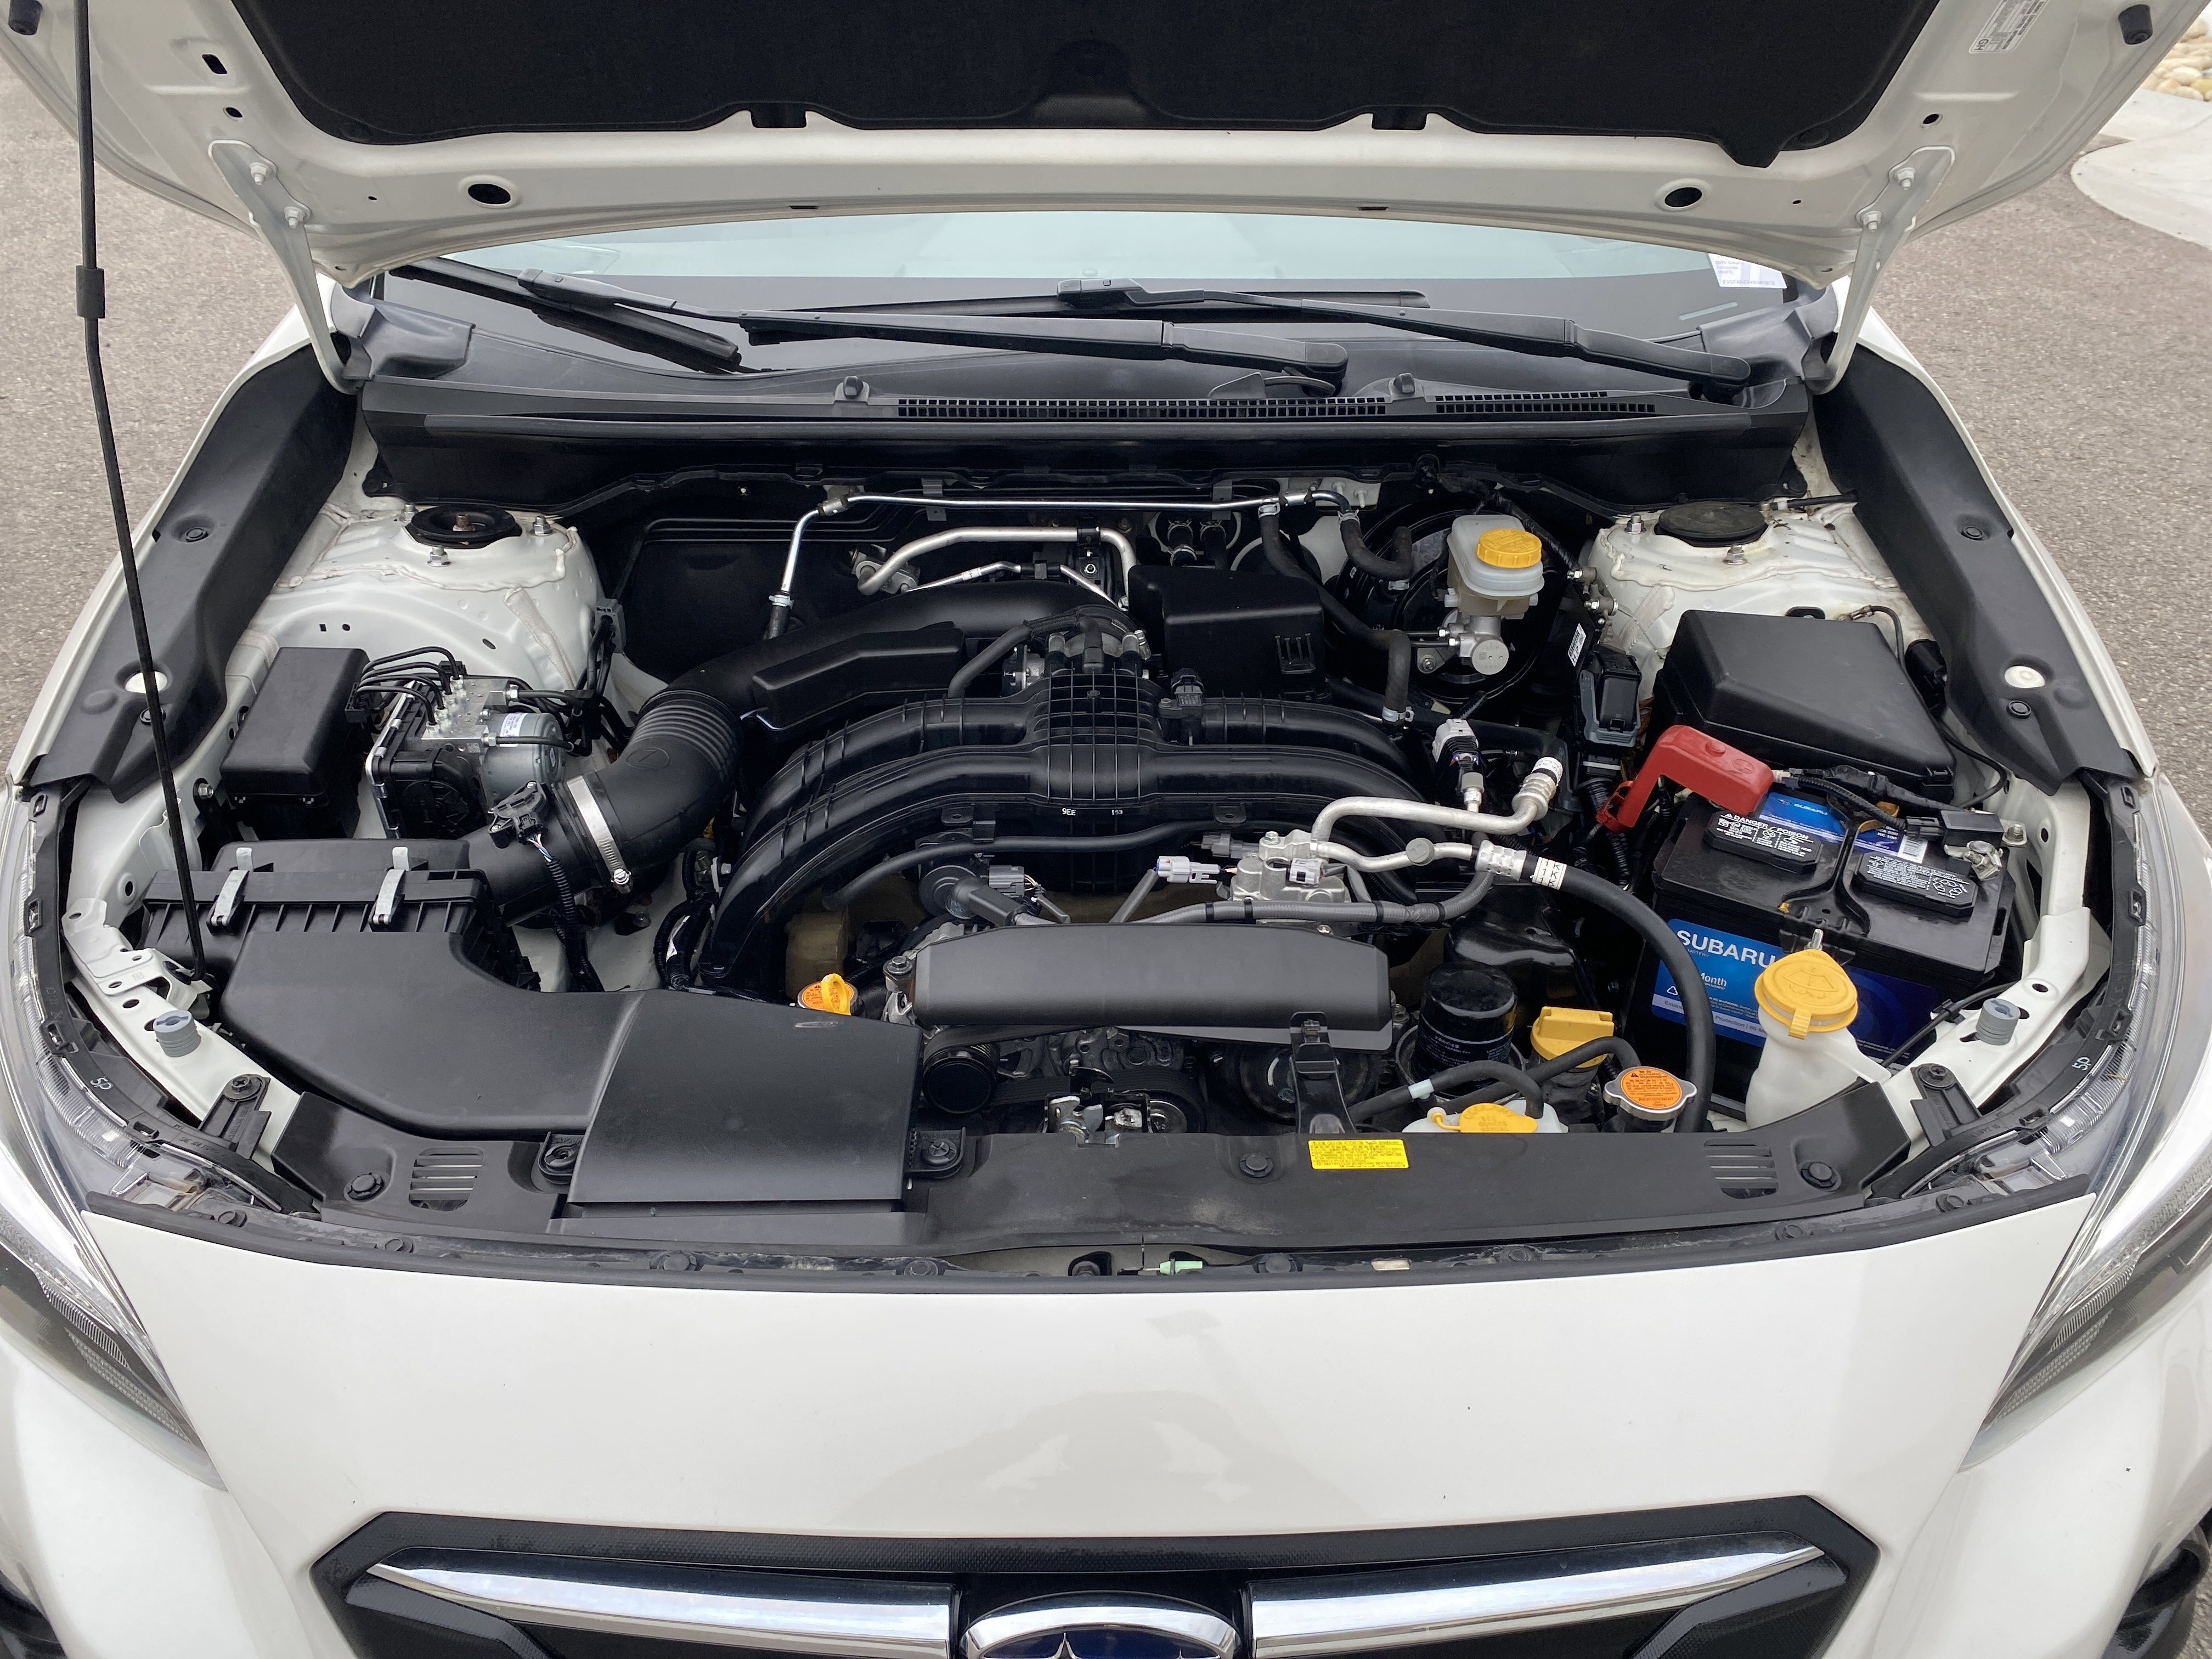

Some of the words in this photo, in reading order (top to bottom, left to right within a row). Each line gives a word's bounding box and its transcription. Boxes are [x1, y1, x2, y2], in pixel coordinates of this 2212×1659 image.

[1974, 38, 1989, 50] GH
[1793, 803, 1829, 816] SUBARU
[1734, 815, 1769, 828] DANGER
[1776, 827, 1809, 839] POISON
[1677, 930, 1776, 968] SUBARU
[1715, 1015, 1745, 1028] Protection
